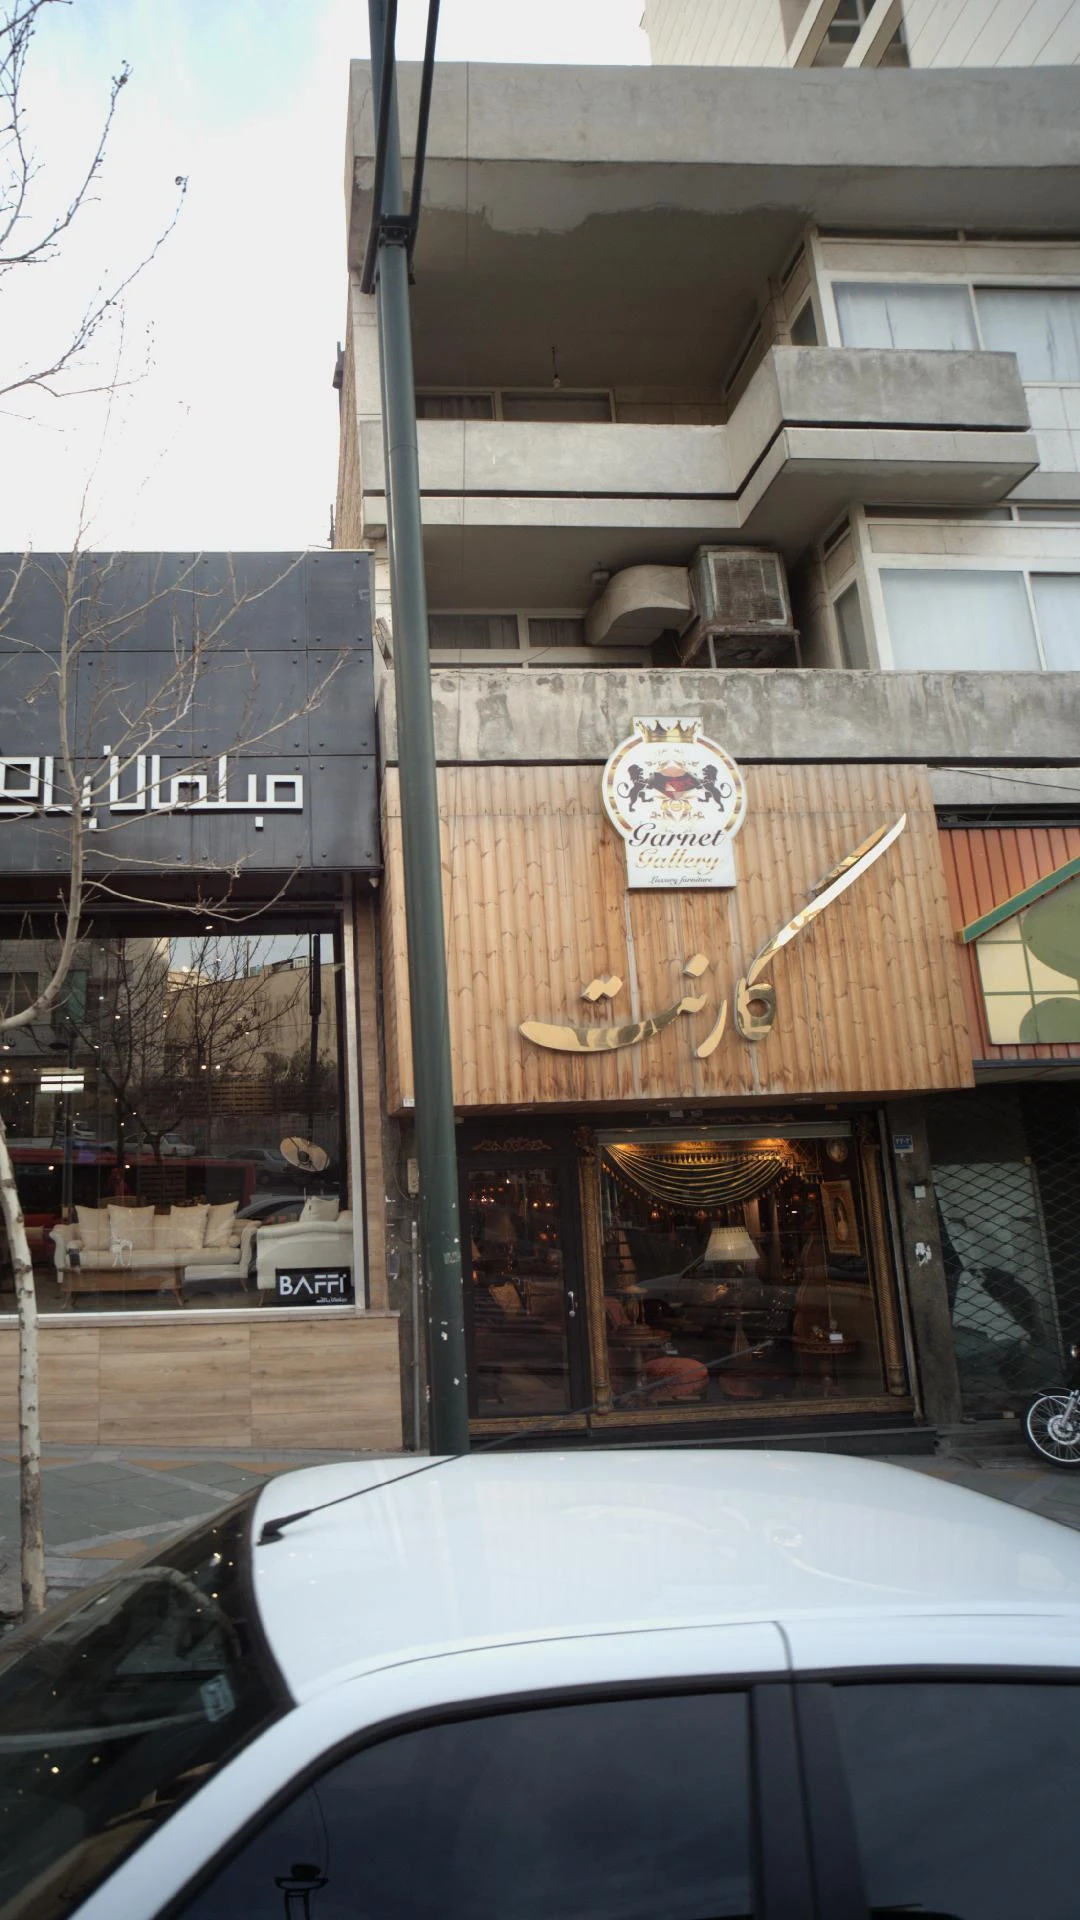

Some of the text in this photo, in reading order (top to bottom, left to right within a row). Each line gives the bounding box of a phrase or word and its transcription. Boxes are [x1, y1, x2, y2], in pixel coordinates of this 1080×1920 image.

[104, 745, 304, 828] مبلمان
[628, 822, 724, 847] Garnet
[635, 848, 719, 875] Gallery
[519, 813, 906, 1059] گارنت
[280, 1274, 345, 1295] BAFFI
